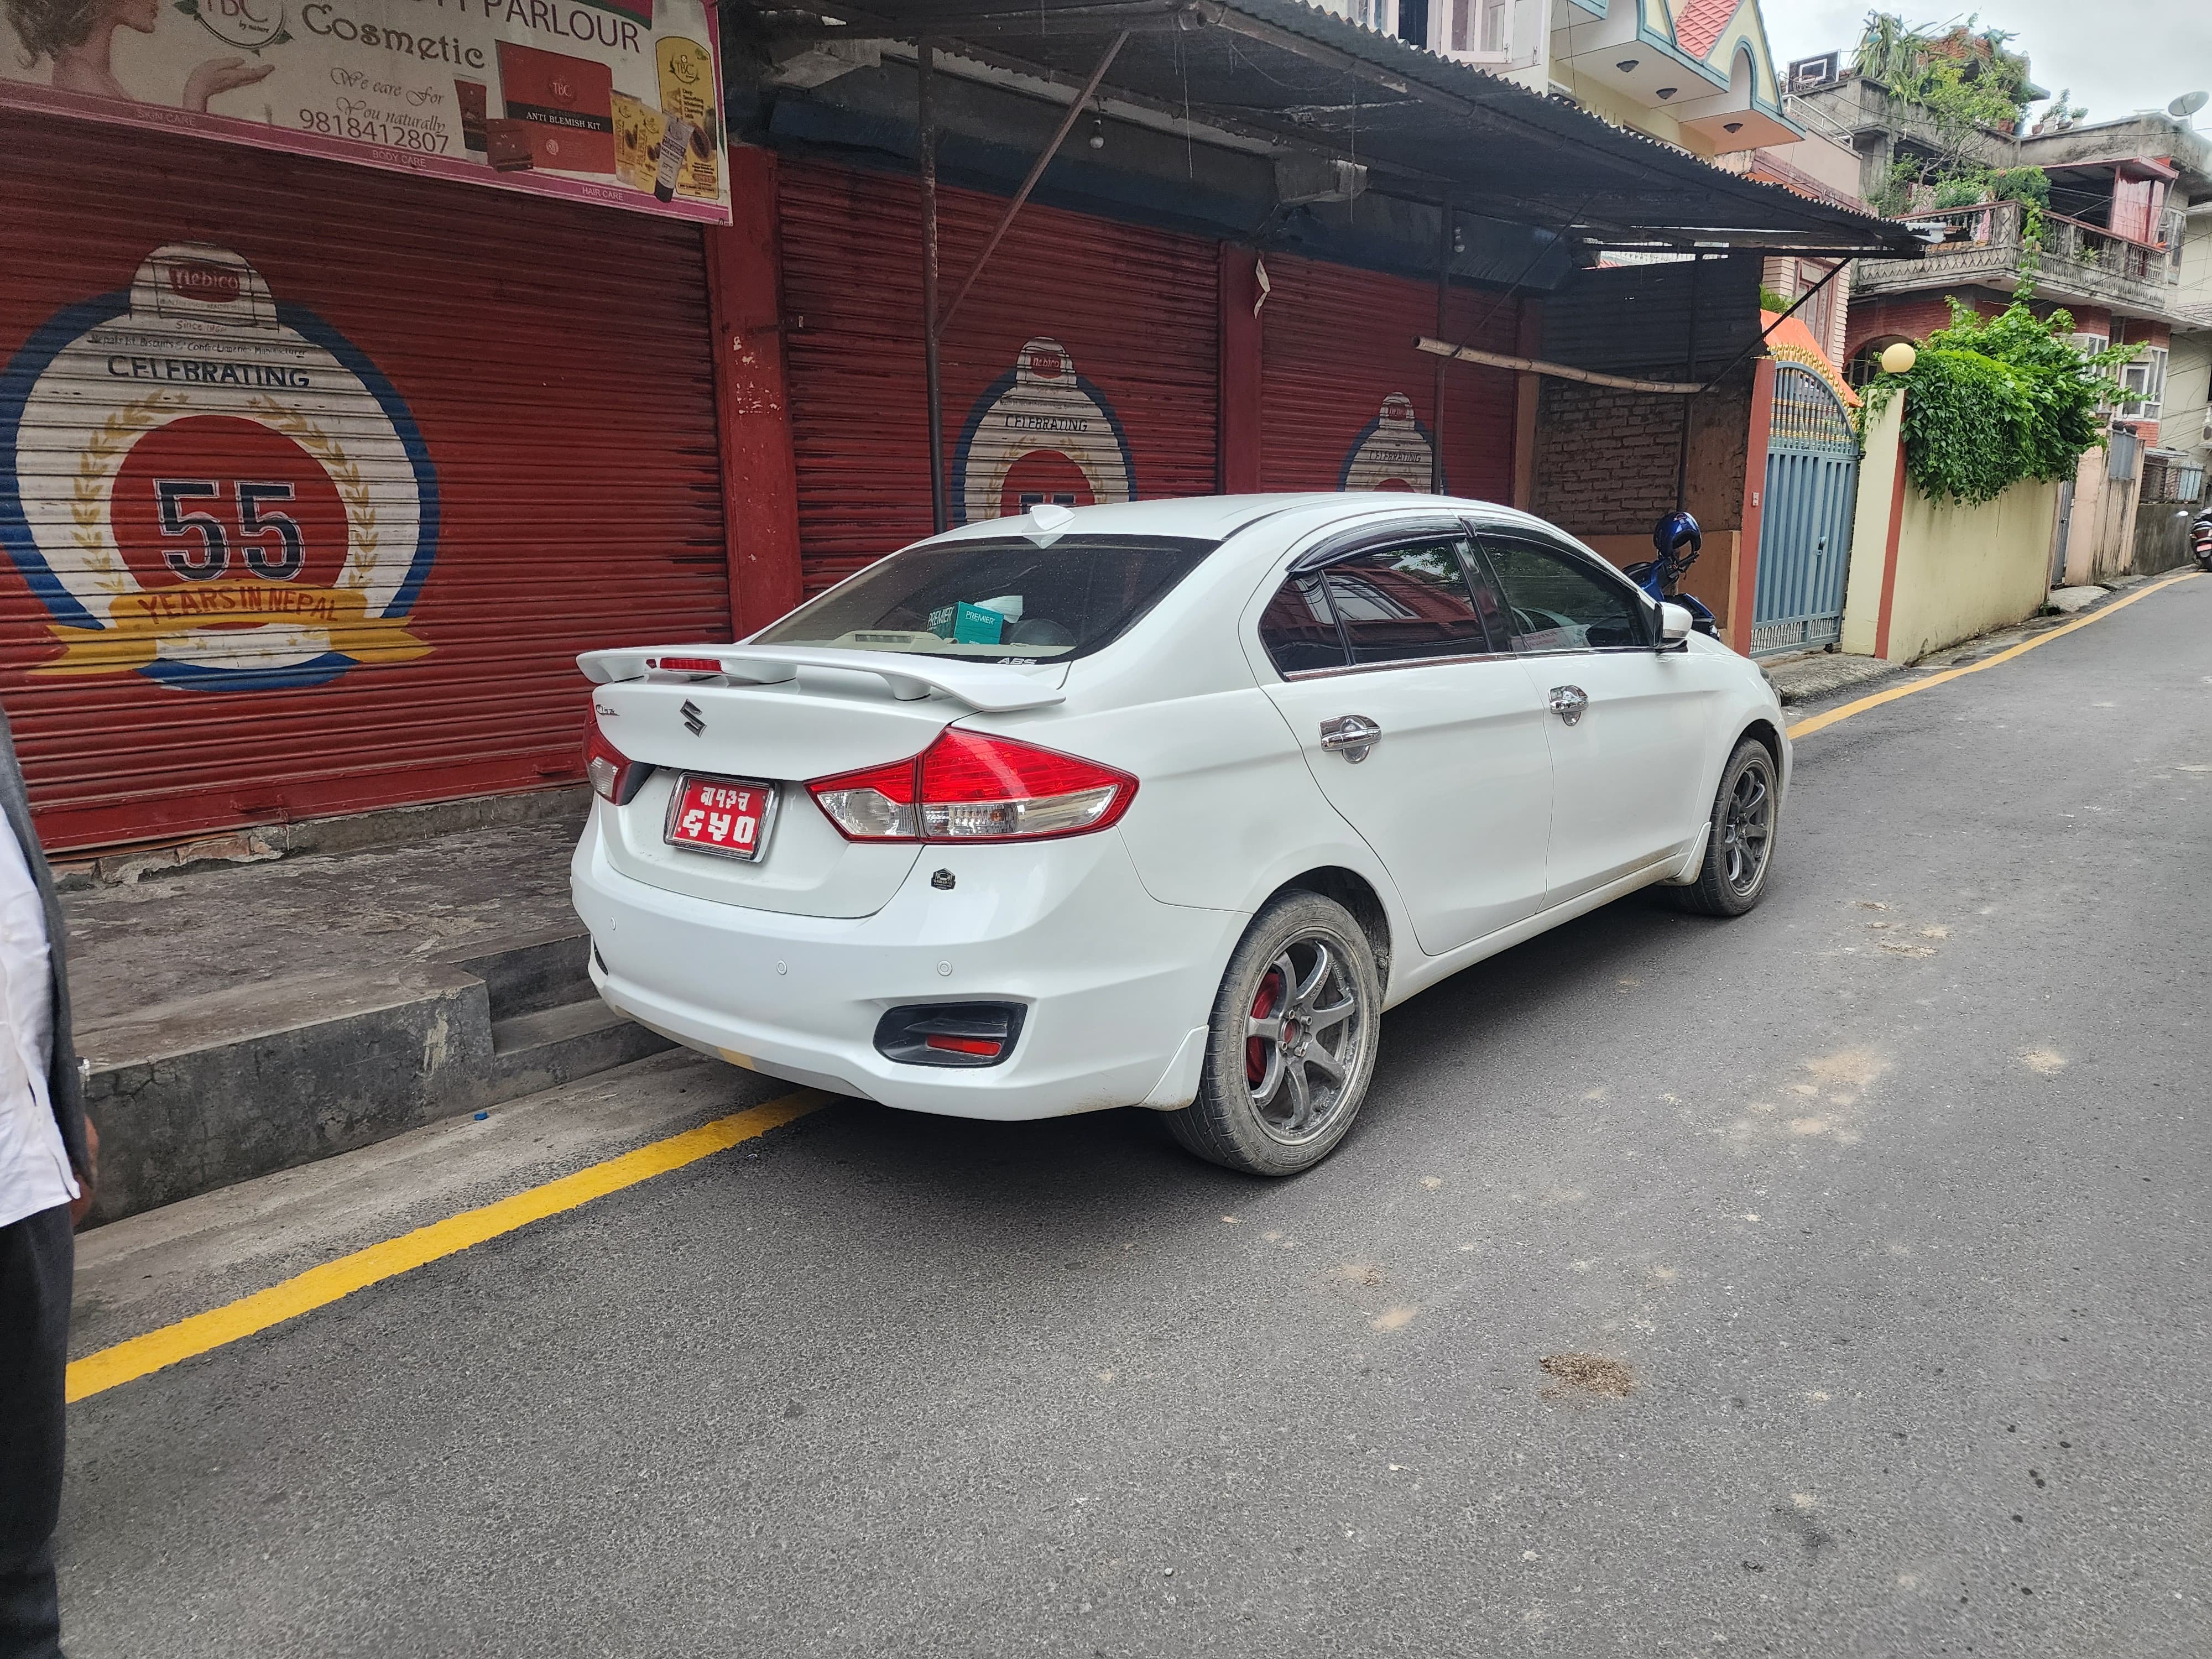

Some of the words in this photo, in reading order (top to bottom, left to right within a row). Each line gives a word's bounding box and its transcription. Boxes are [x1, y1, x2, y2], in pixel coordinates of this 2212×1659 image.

[302, 3, 485, 69] Cosmetic
[483, 0, 640, 53] PARLOUR
[331, 67, 369, 89] We
[373, 82, 402, 96] care
[552, 82, 573, 97] TBC
[336, 97, 380, 119] You
[385, 112, 446, 134] naturally
[526, 111, 547, 123] ANTI
[549, 115, 586, 128] BLEMISH
[587, 121, 601, 131] KIT
[300, 108, 449, 154] 9818412807
[372, 150, 399, 161] BODY
[401, 155, 426, 168] CARE
[582, 186, 601, 197] HAIR
[602, 190, 624, 201] CARE
[107, 355, 310, 388] CELEBRATING
[1005, 415, 1088, 432] CELEBRATING
[153, 478, 306, 582] 55
[138, 586, 236, 624] YEARS
[239, 586, 263, 612] IN
[268, 587, 339, 622] NEPAL
[927, 607, 953, 629] PREMIER
[966, 611, 994, 625] PREMIER
